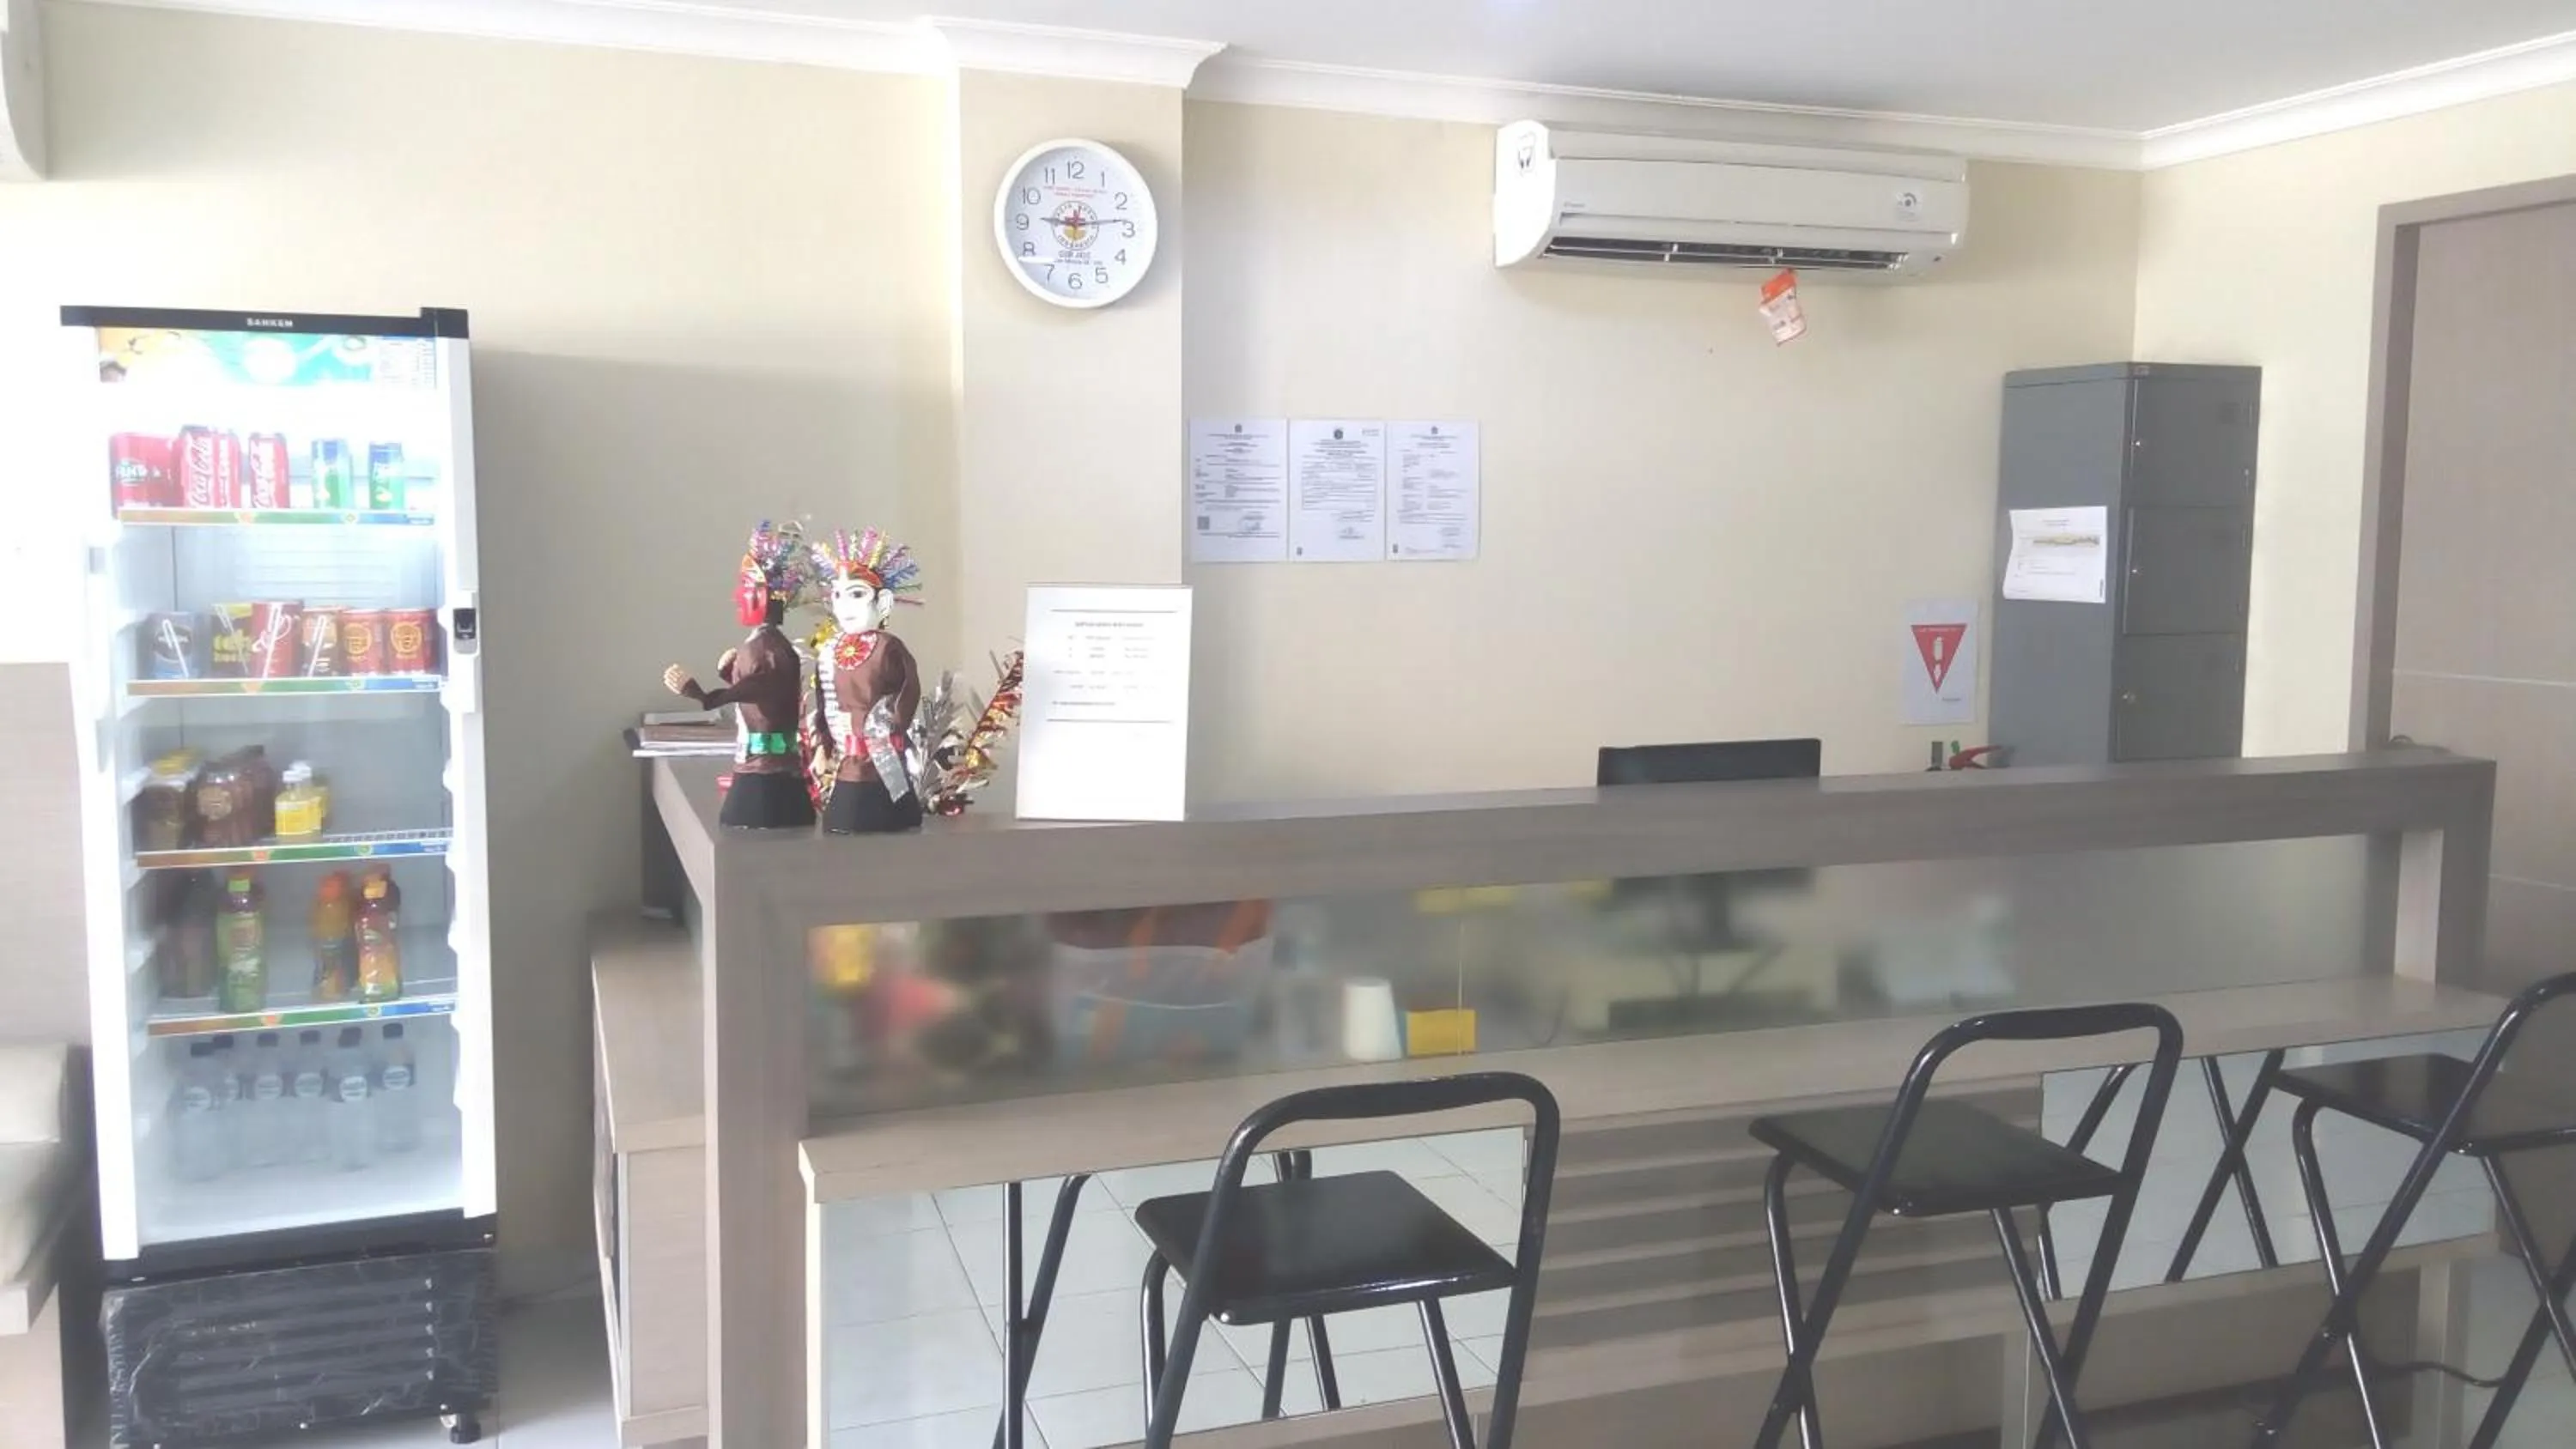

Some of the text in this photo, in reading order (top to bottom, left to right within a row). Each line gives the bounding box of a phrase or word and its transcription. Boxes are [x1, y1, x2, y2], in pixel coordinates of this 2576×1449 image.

[1044, 167, 1056, 185] 11
[1066, 161, 1085, 179] 12
[1100, 171, 1106, 188] 1
[1023, 187, 1042, 205] 10
[1114, 191, 1128, 210] 2
[1016, 213, 1030, 231] 9
[1121, 219, 1136, 239] 3
[1022, 241, 1036, 257] 8
[1114, 248, 1127, 266] 4
[1044, 263, 1056, 283] 7
[1067, 272, 1084, 290] 6
[1095, 266, 1109, 284] 5
